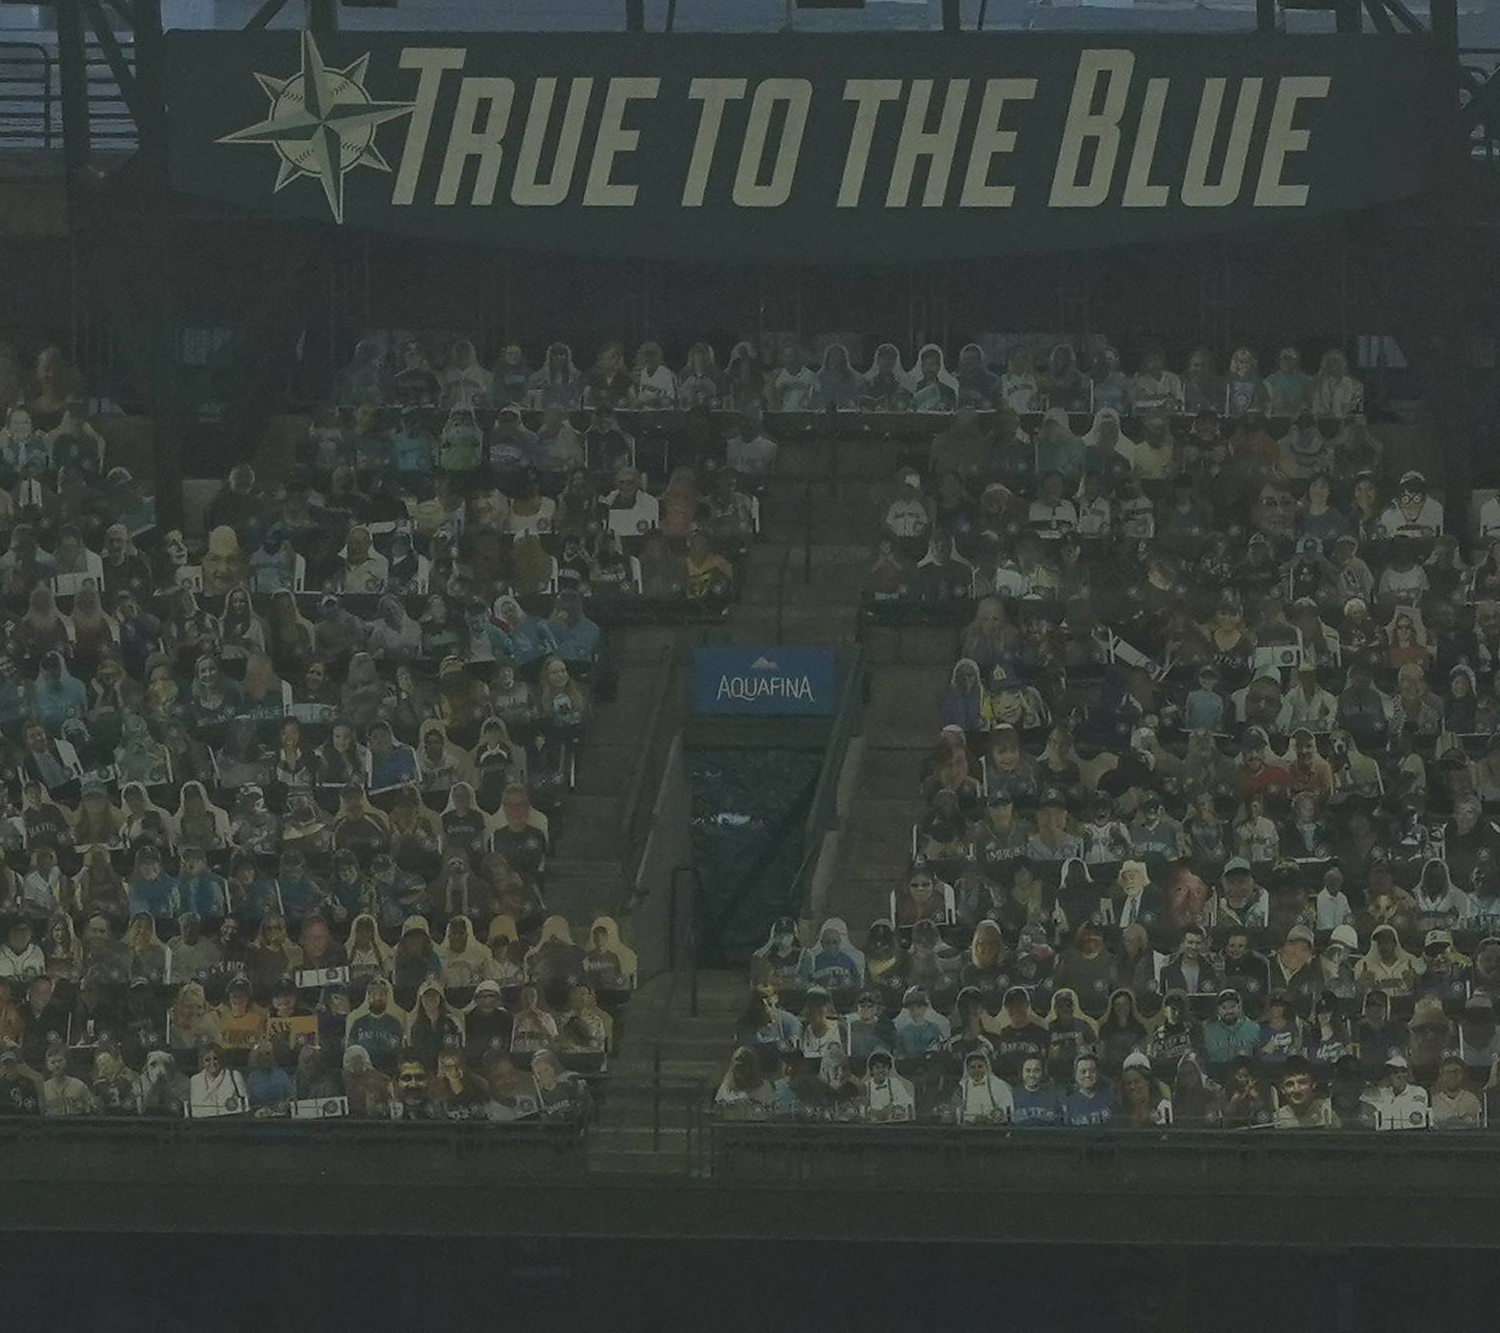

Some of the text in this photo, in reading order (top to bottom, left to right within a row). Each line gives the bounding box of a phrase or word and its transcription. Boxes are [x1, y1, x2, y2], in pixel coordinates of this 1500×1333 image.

[391, 47, 1331, 206] TRUE TO THE BLUE
[717, 675, 815, 702] AQUAFINA
